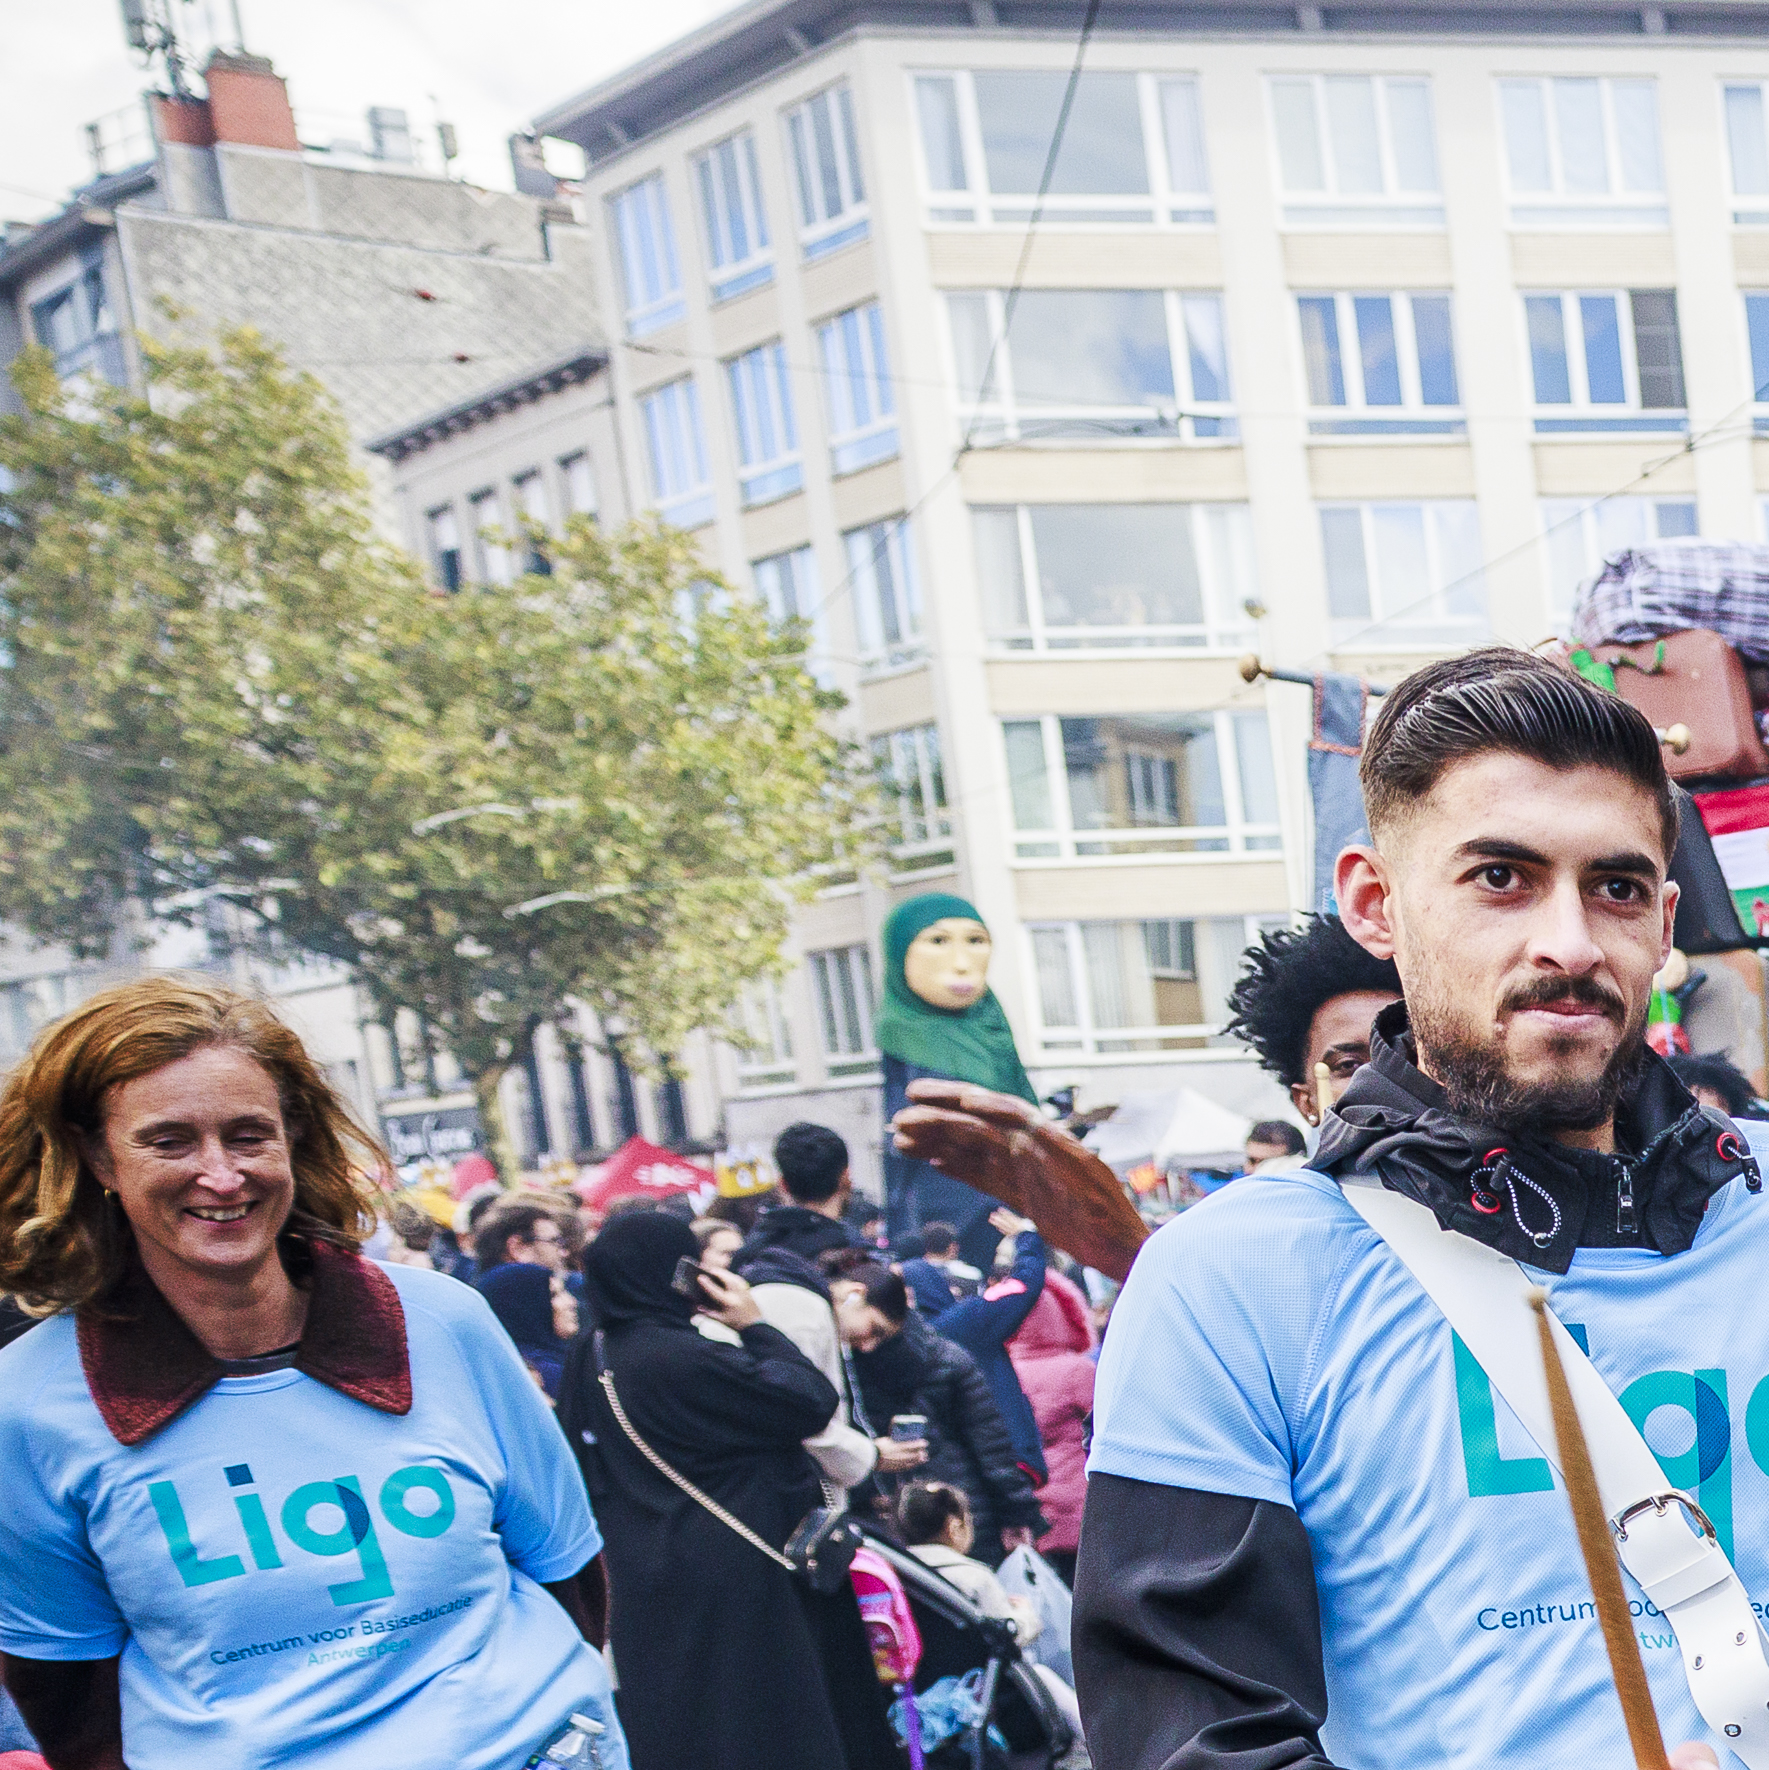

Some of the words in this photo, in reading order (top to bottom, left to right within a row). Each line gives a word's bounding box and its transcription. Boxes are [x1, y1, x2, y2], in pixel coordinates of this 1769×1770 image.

[146, 1463, 456, 1607] Ligo
[209, 1636, 303, 1666] Centrum
[307, 1625, 355, 1644] voor
[360, 1596, 474, 1636] Basiseducatie
[307, 1637, 411, 1668] Antwerpen
